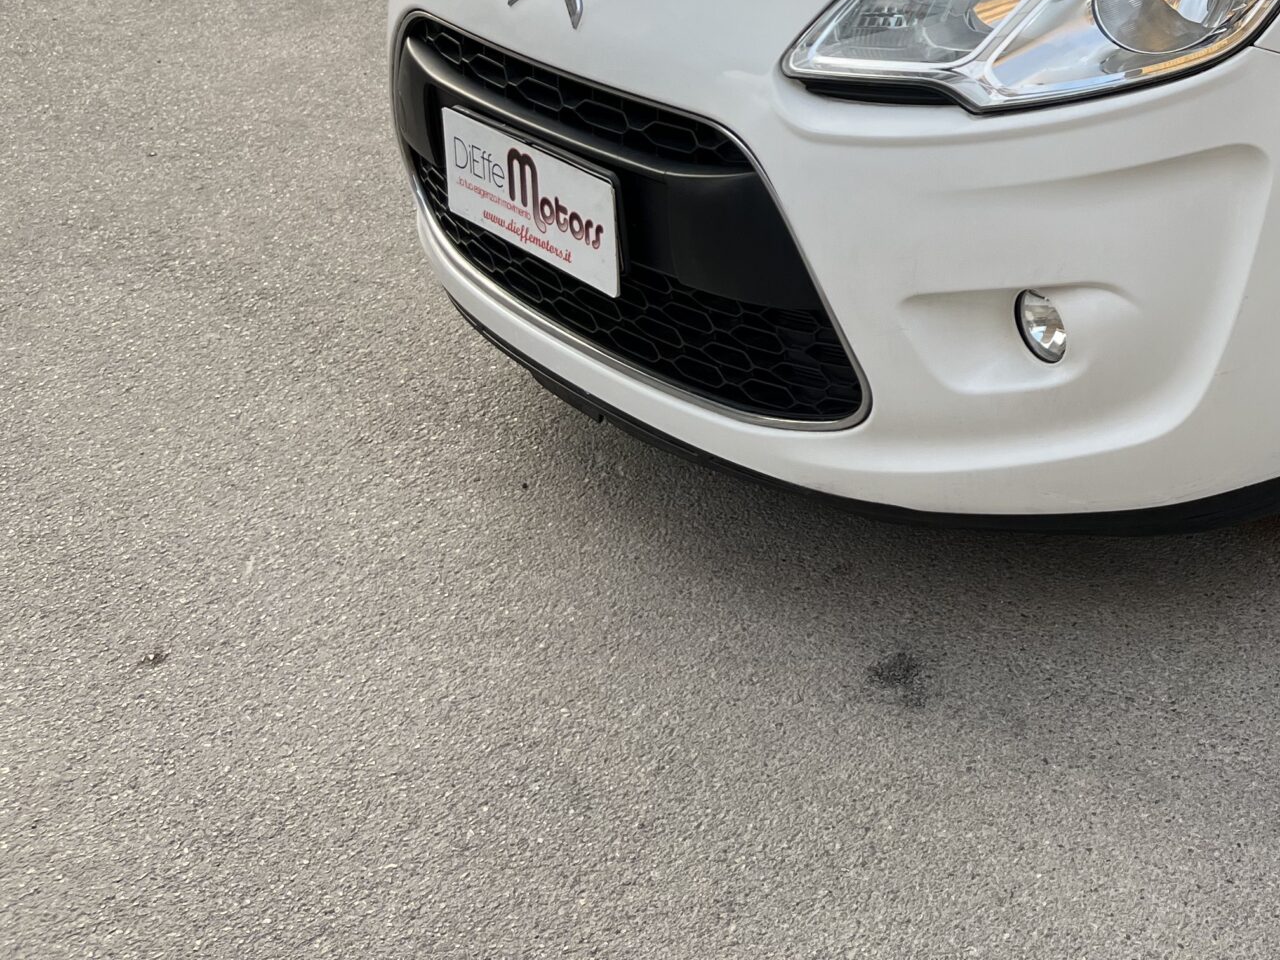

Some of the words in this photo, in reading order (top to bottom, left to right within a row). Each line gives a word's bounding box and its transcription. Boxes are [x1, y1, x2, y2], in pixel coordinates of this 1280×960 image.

[453, 136, 506, 189] DiEffe
[507, 147, 604, 250] Motors
[482, 209, 573, 264] www.dieffemotors.it
